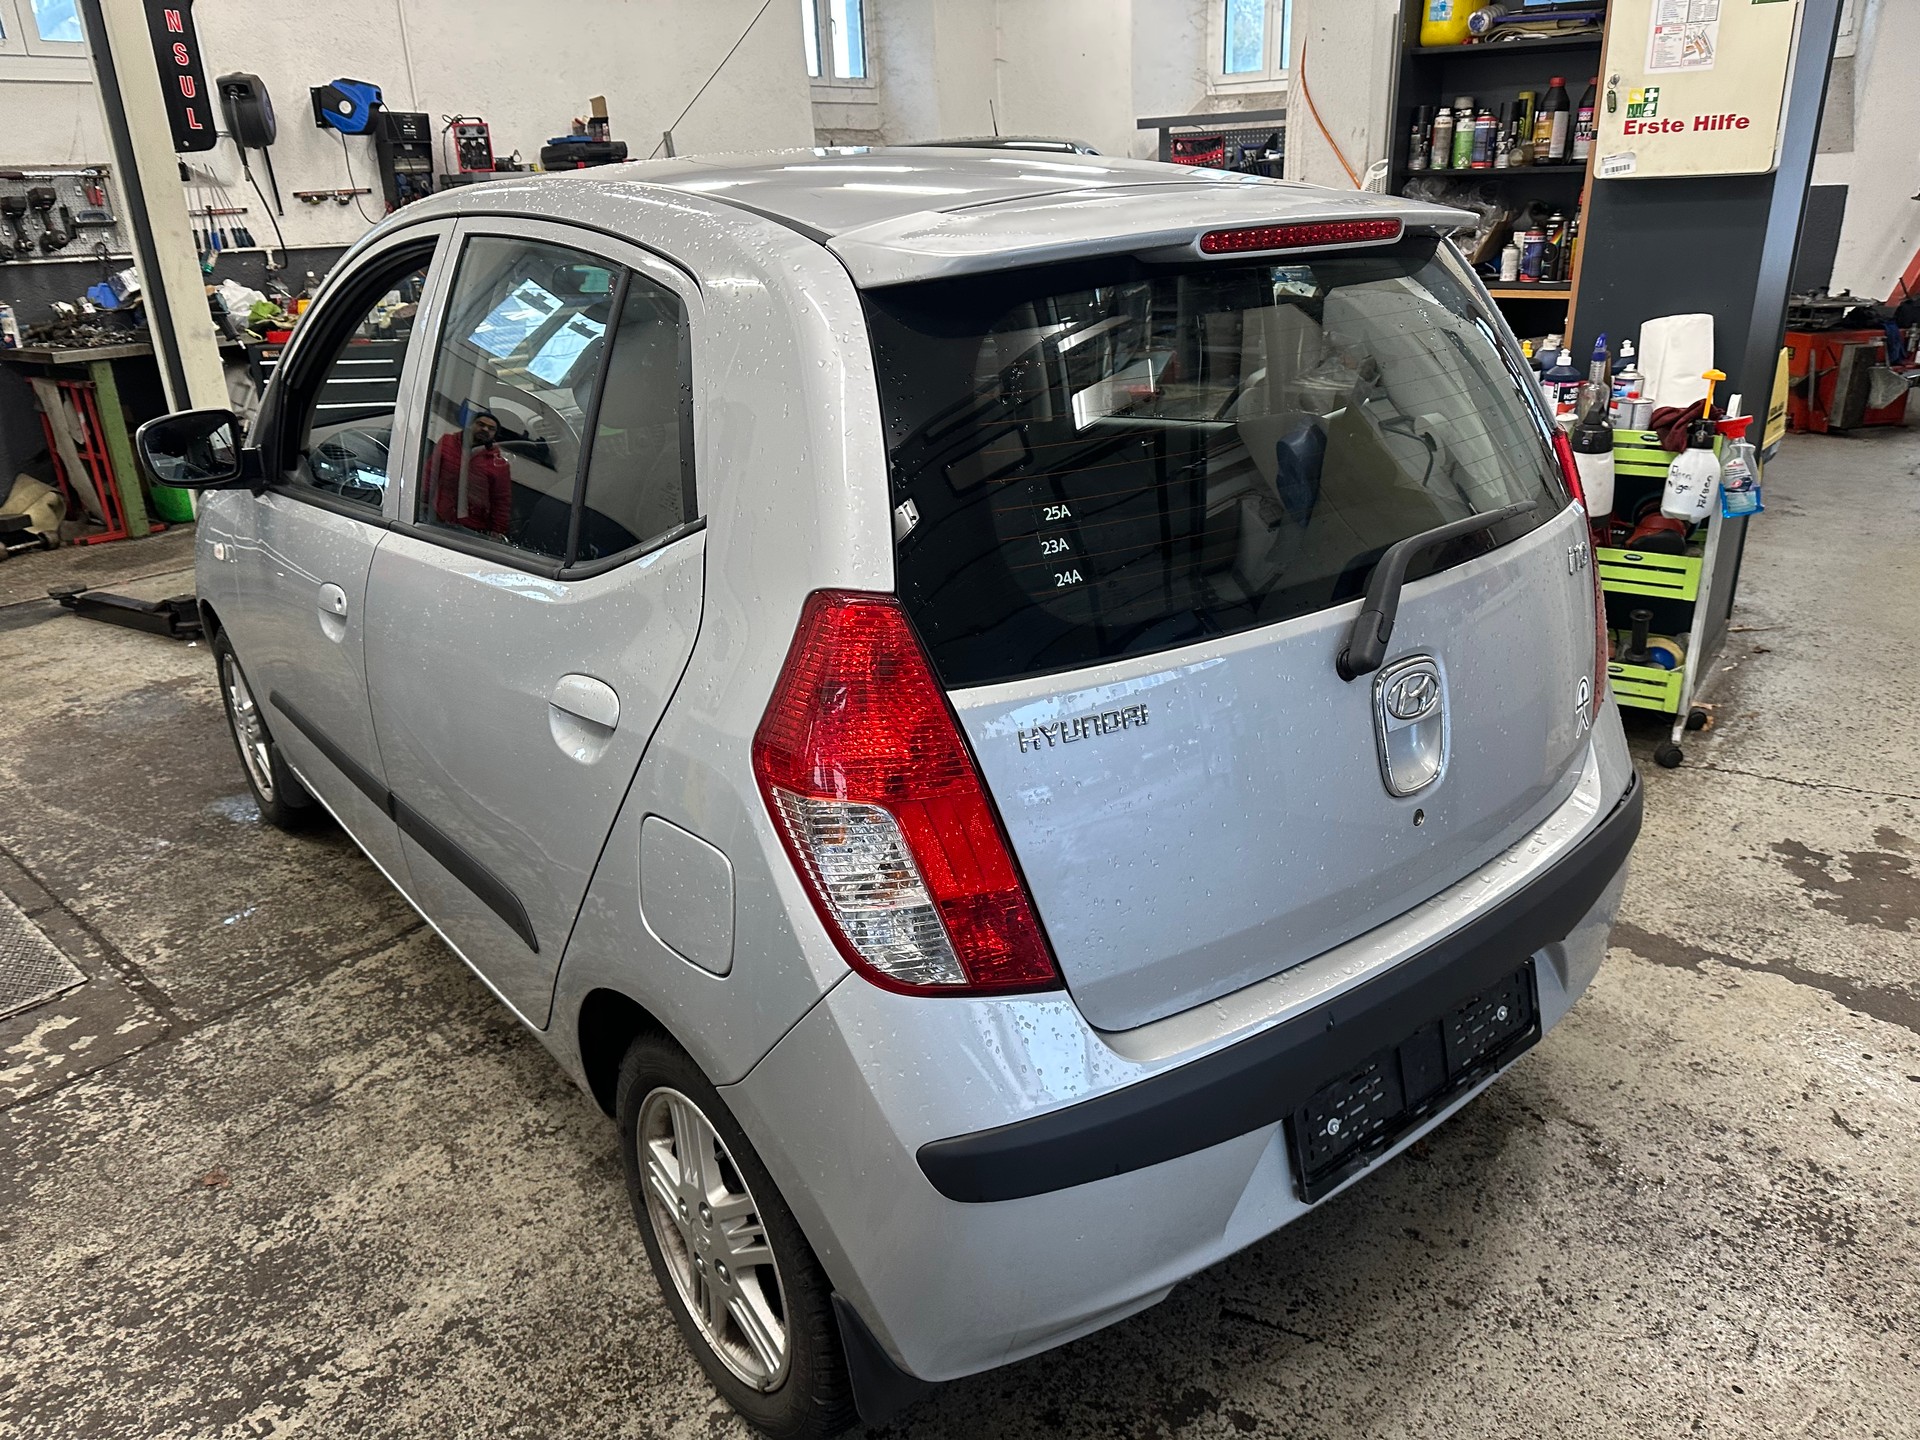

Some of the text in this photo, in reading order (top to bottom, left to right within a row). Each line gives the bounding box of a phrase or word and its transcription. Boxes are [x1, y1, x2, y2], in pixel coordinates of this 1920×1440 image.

[1623, 113, 1750, 136] Erste Hilfe
[1043, 504, 1072, 521] 25A
[1041, 537, 1070, 555] 23A
[1054, 569, 1083, 587] 24A
[1017, 703, 1149, 753] HYUNDAI
